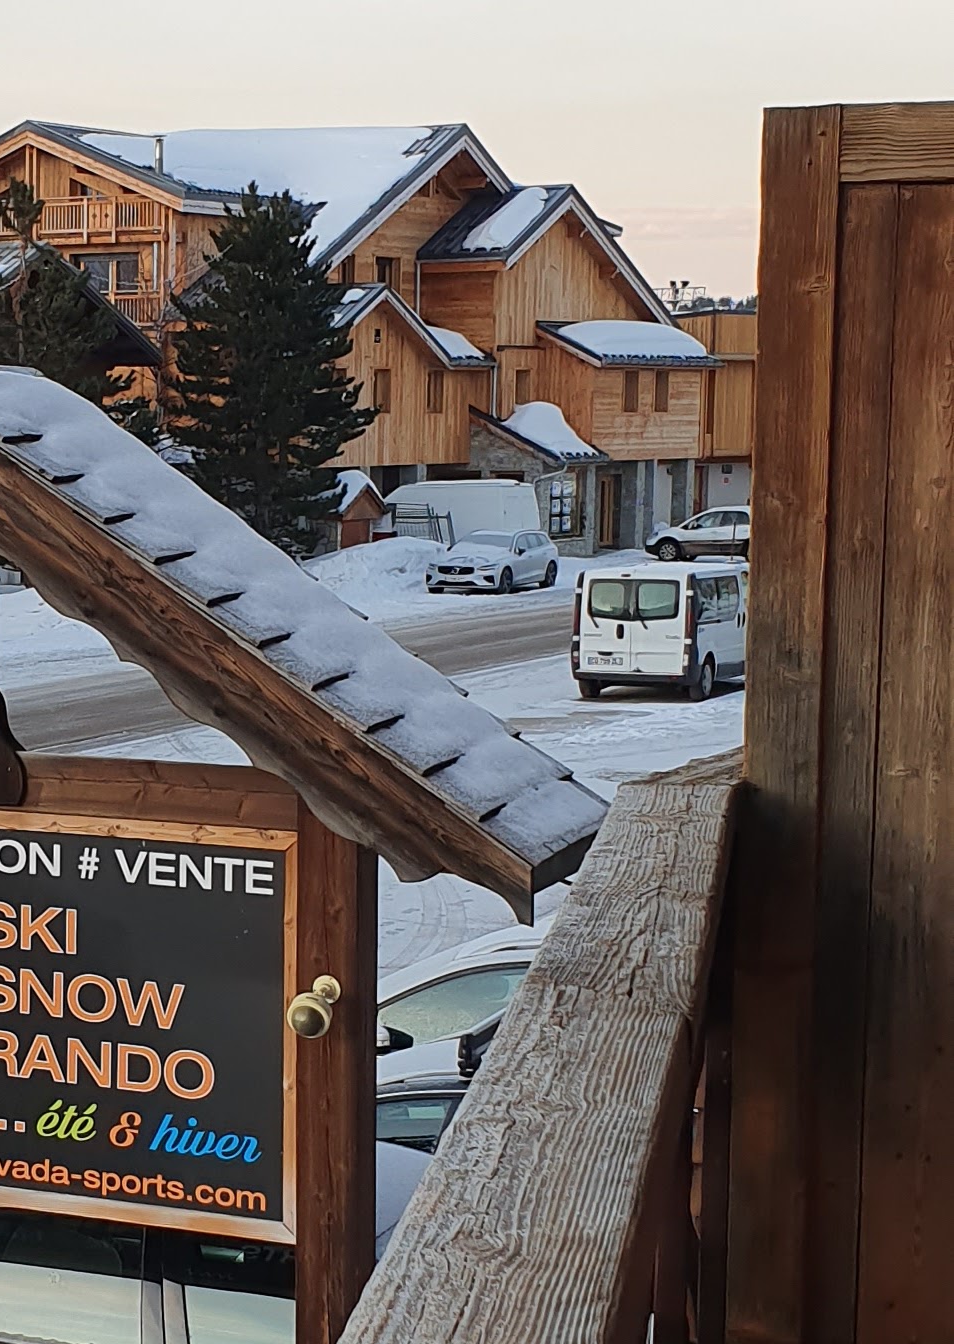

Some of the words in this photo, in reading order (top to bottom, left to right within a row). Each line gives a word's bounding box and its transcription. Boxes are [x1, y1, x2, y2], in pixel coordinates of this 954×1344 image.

[77, 846, 100, 880] #
[114, 848, 275, 896] VENTE
[108, 1111, 143, 1148] &
[148, 1113, 263, 1164] hiver
